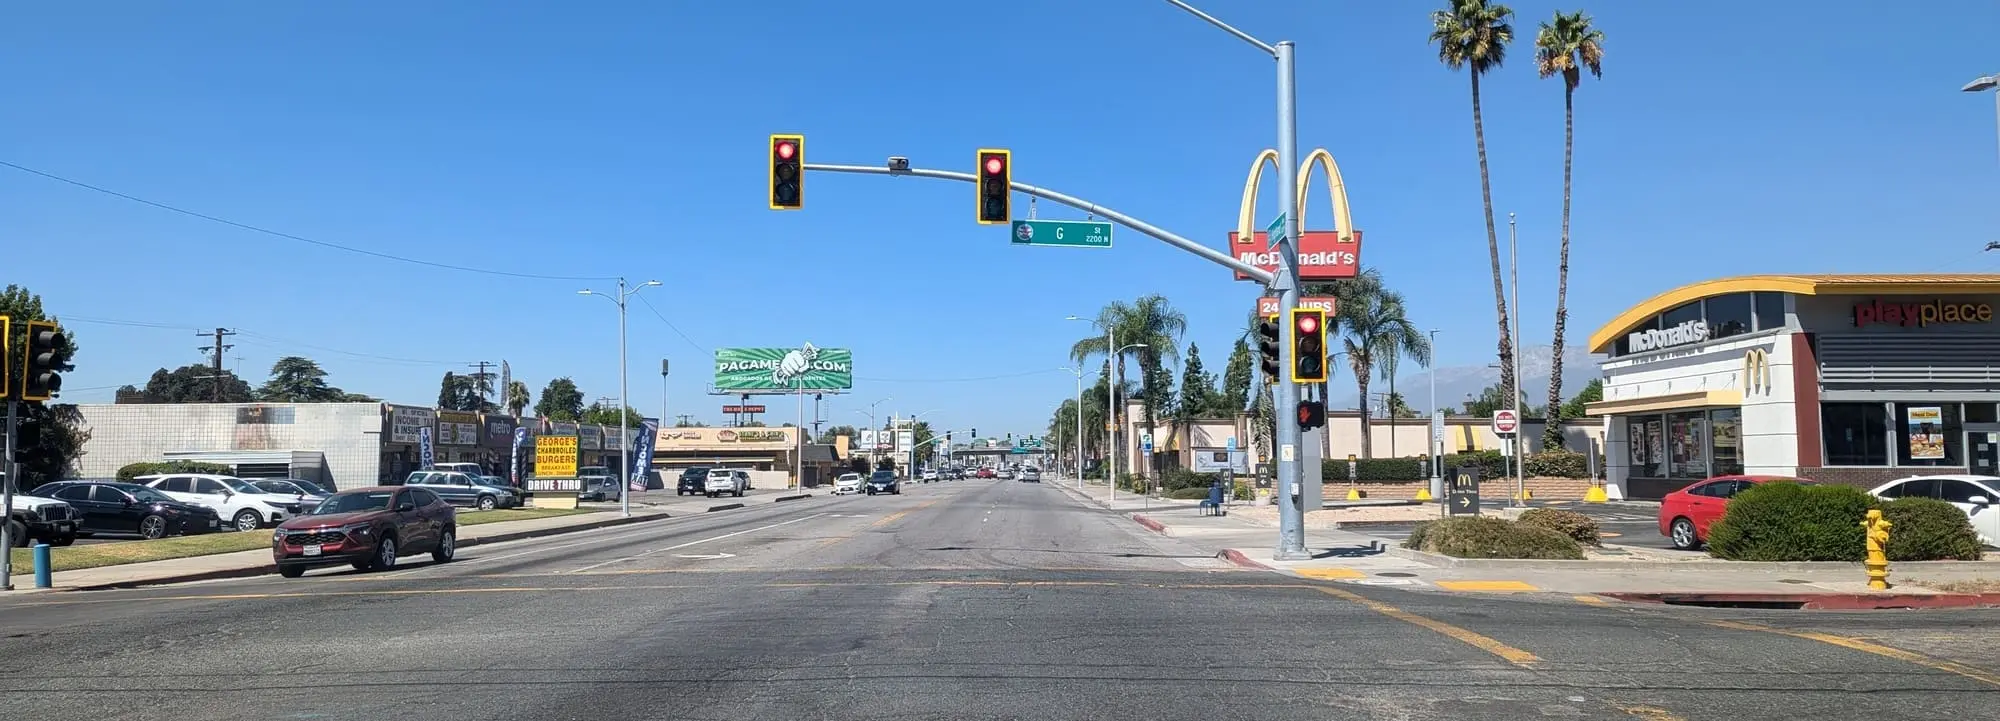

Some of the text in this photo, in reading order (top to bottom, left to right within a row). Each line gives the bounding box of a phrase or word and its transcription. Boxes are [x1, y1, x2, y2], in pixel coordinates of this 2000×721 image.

[1056, 227, 1064, 240] G
[1085, 235, 1102, 243] 2200
[1239, 250, 1355, 266] McDnald's
[1262, 302, 1279, 313] 24
[1855, 298, 1993, 328] playplace
[1629, 319, 1707, 353] McDonald's
[395, 415, 420, 425] INCOME
[423, 417, 434, 426] TAX
[490, 420, 511, 435] metro
[537, 437, 577, 446] GEORGE'S
[537, 447, 576, 455] CHARBROILED
[536, 455, 576, 464] BURGERS
[527, 480, 581, 491] DRIVE THRU
